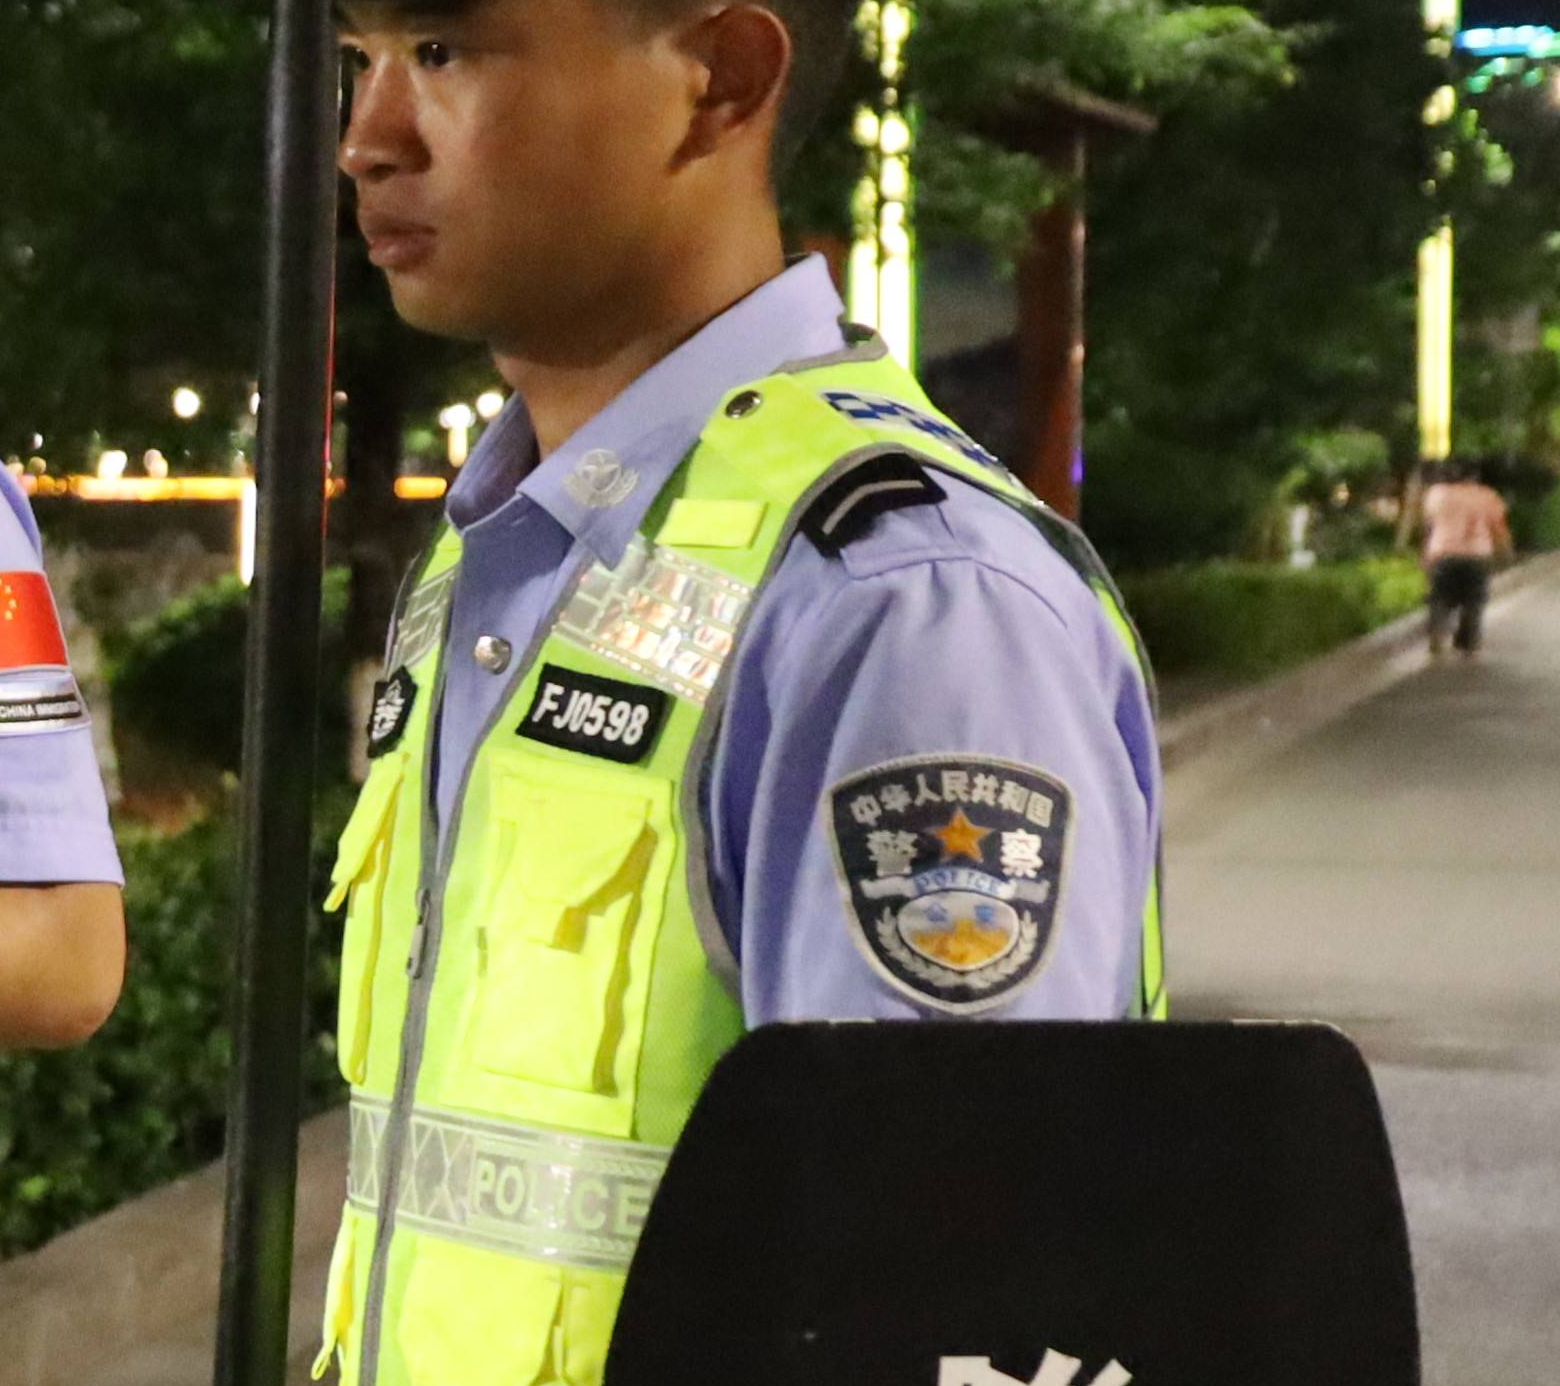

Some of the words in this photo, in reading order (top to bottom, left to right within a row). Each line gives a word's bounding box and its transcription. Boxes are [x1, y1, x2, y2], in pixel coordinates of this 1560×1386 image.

[531, 682, 650, 746] FJ0598
[850, 770, 1055, 828] 中华人民共和国
